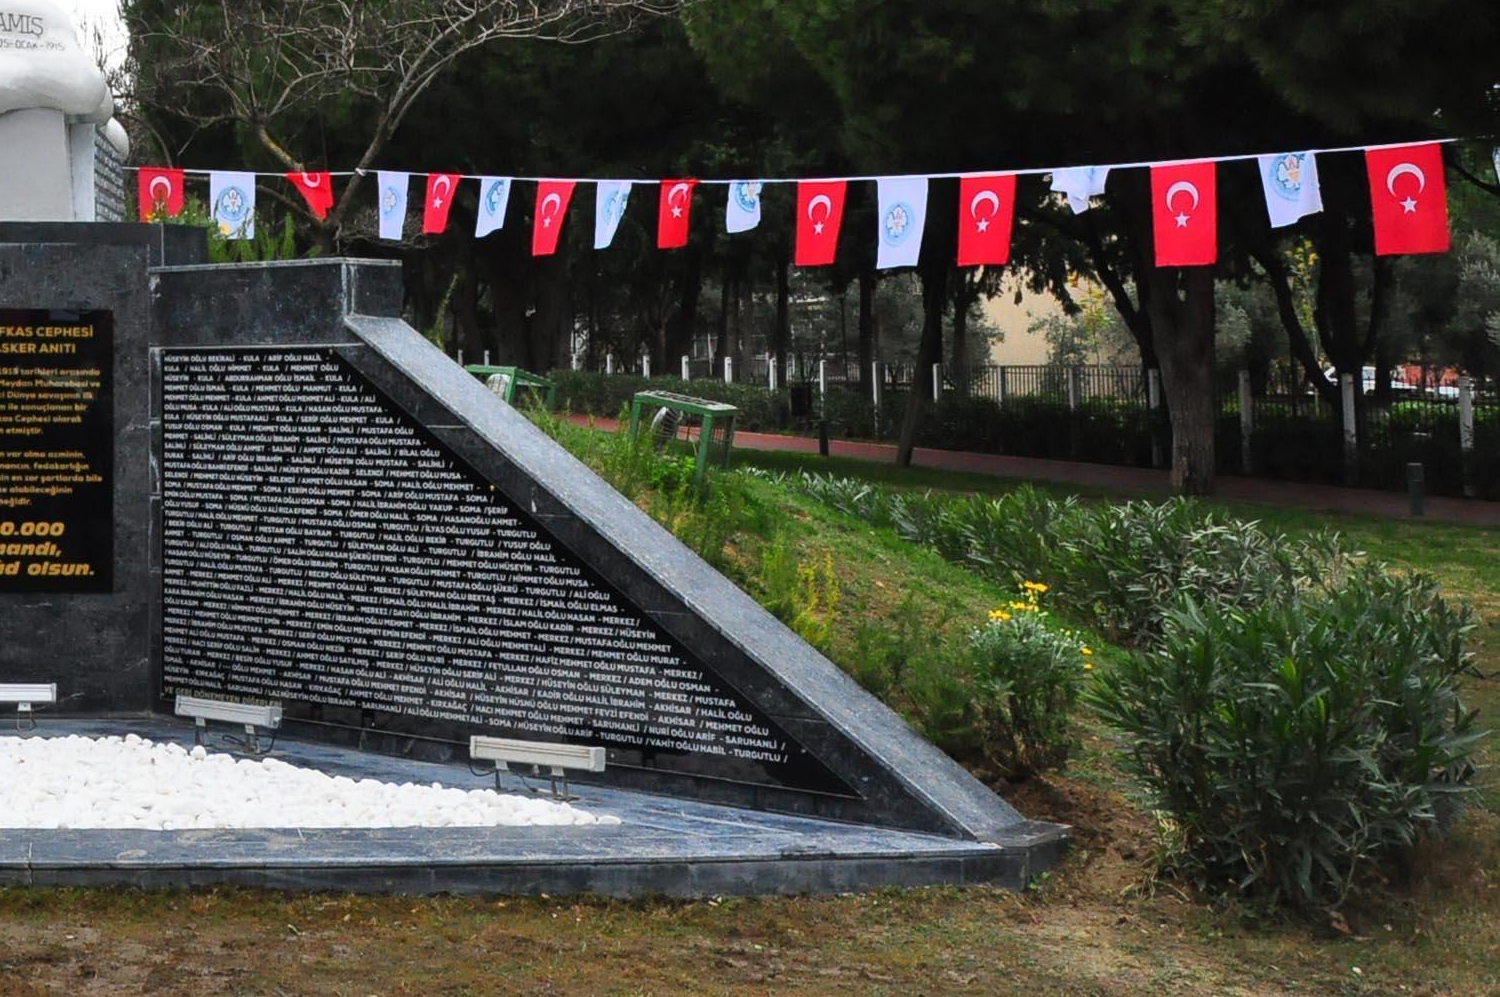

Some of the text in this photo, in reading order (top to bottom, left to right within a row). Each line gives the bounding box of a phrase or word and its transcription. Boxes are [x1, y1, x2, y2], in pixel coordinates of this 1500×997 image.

[36, 326, 94, 337] CEPHESİ
[40, 342, 76, 353] ANITI
[28, 561, 94, 575] olsun.
